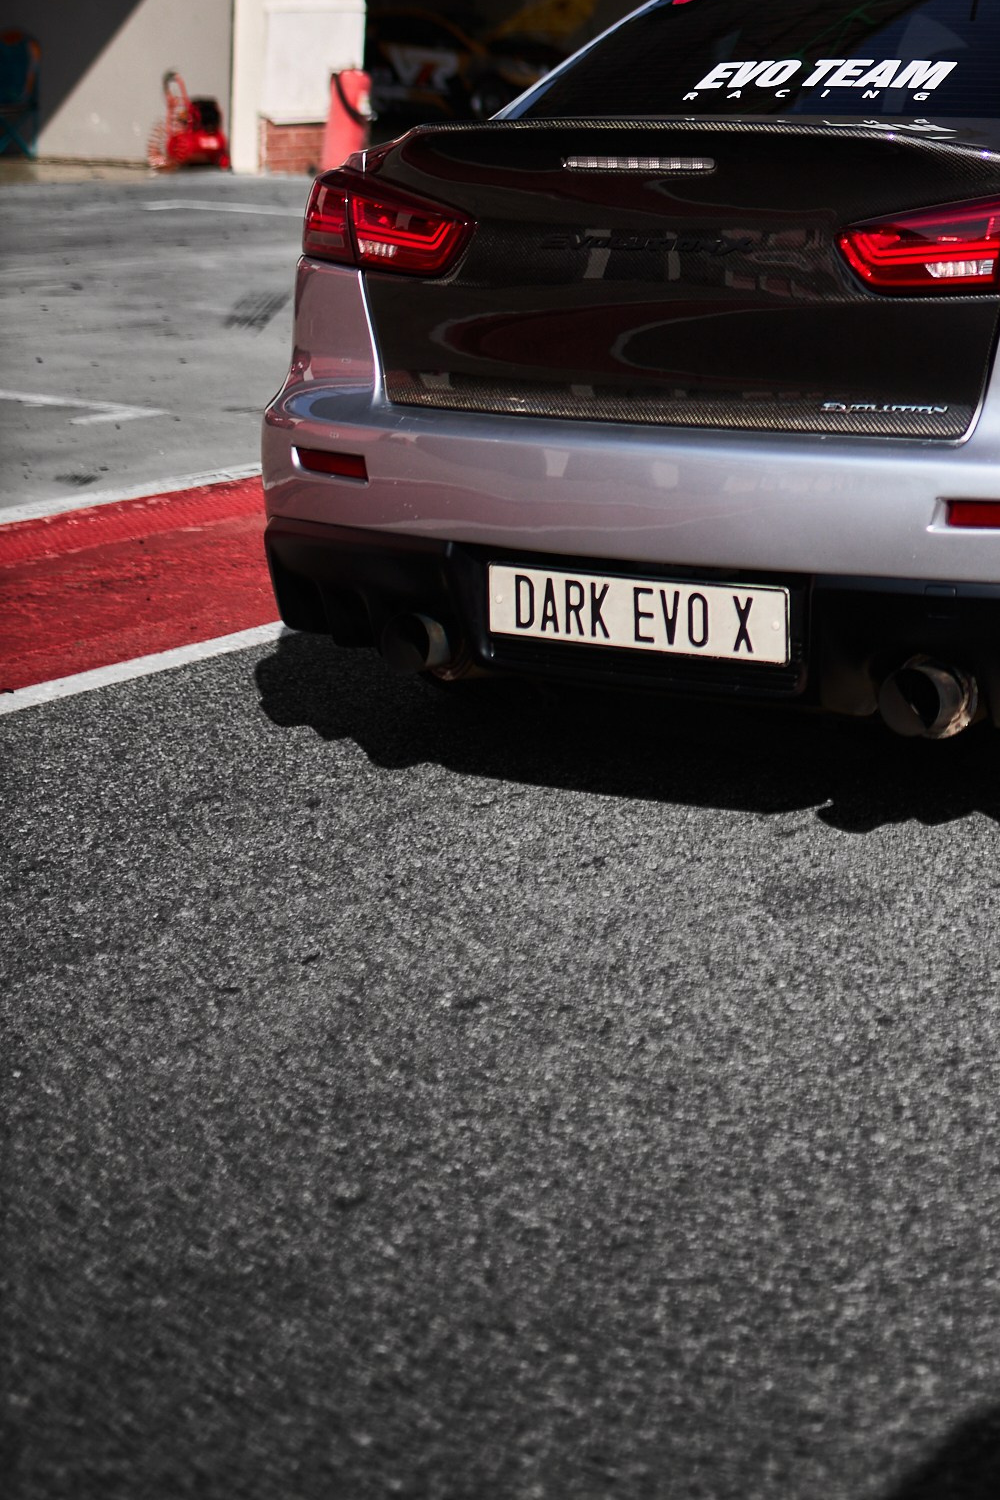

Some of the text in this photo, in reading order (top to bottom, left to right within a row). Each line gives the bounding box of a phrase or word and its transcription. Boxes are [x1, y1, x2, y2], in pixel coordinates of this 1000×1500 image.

[694, 59, 958, 90] EVO TEAM
[682, 88, 932, 102] RACING
[514, 574, 754, 653] DARK EVO X
